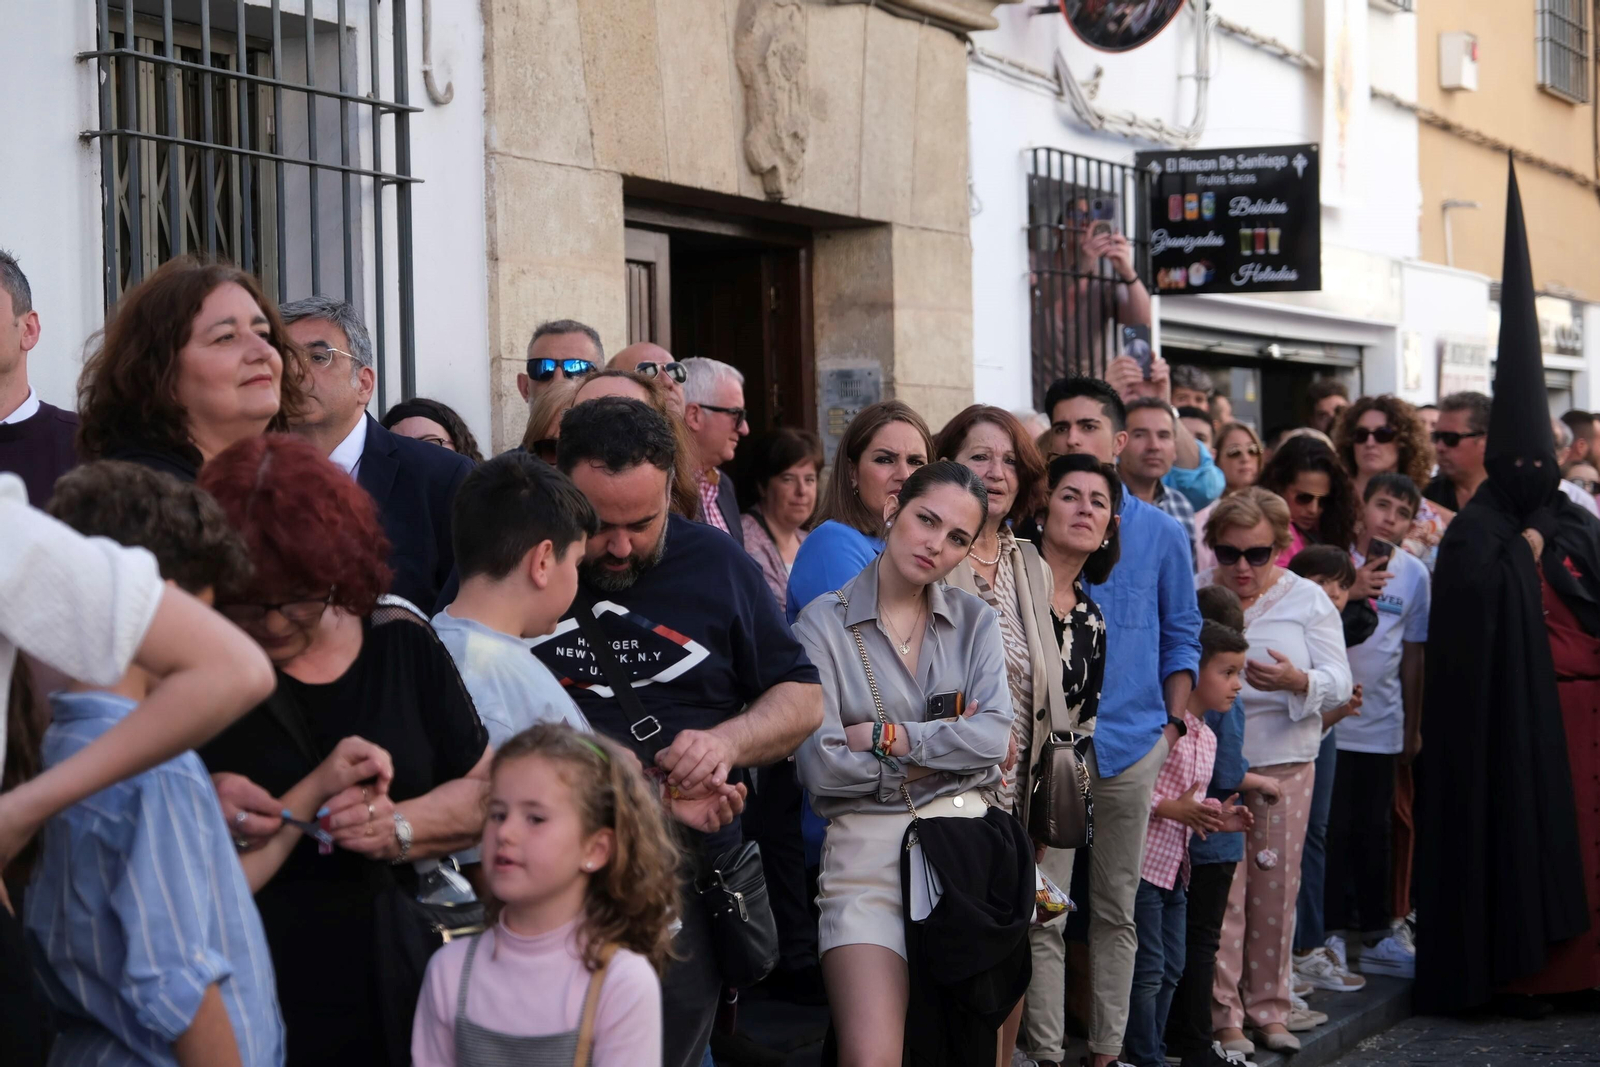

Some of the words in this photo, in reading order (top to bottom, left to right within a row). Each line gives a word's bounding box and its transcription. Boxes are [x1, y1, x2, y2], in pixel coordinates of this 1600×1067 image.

[1165, 158, 1178, 173] El
[1219, 155, 1236, 171] De
[1236, 153, 1289, 171] Santiago
[1196, 173, 1227, 186] Frutos
[1227, 172, 1258, 185] Secos
[1228, 196, 1289, 217] Bebidas
[555, 646, 586, 660] NEW
